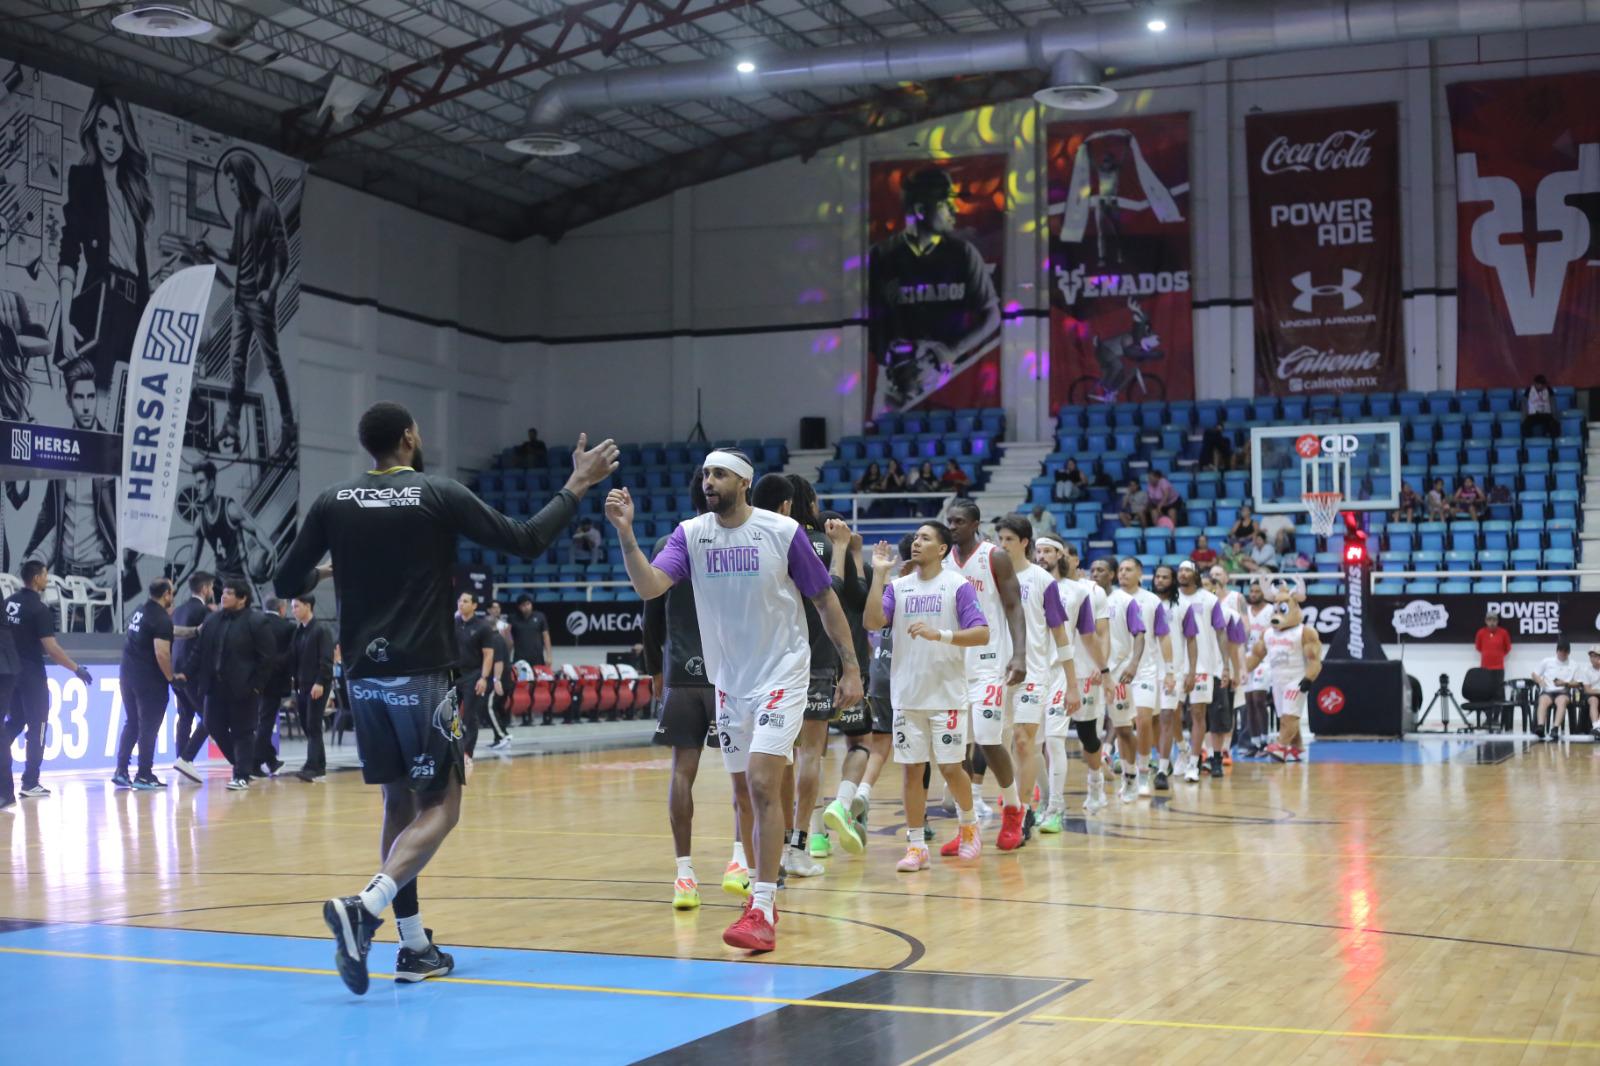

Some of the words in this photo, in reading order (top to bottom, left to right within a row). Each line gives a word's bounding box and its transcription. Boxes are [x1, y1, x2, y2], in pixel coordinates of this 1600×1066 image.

[1261, 129, 1376, 174] Coca-Cola
[1270, 198, 1373, 227] POWER
[1318, 221, 1373, 246] ADE
[1280, 317, 1321, 328] UNDER
[1324, 314, 1377, 326] ARMOUR
[1277, 345, 1381, 379] Caliente
[1303, 376, 1377, 390] caliente.mx
[35, 435, 80, 455] HERSA
[128, 373, 168, 500] HERSA
[162, 386, 182, 489] CORPORATIVO
[336, 486, 421, 503] EXTREME
[706, 548, 760, 573] VENADOS
[905, 594, 942, 613] VENADOS
[1487, 601, 1559, 619] POWER
[1519, 618, 1560, 634] ADE
[353, 685, 420, 706] SoniGas
[766, 688, 785, 710] 2
